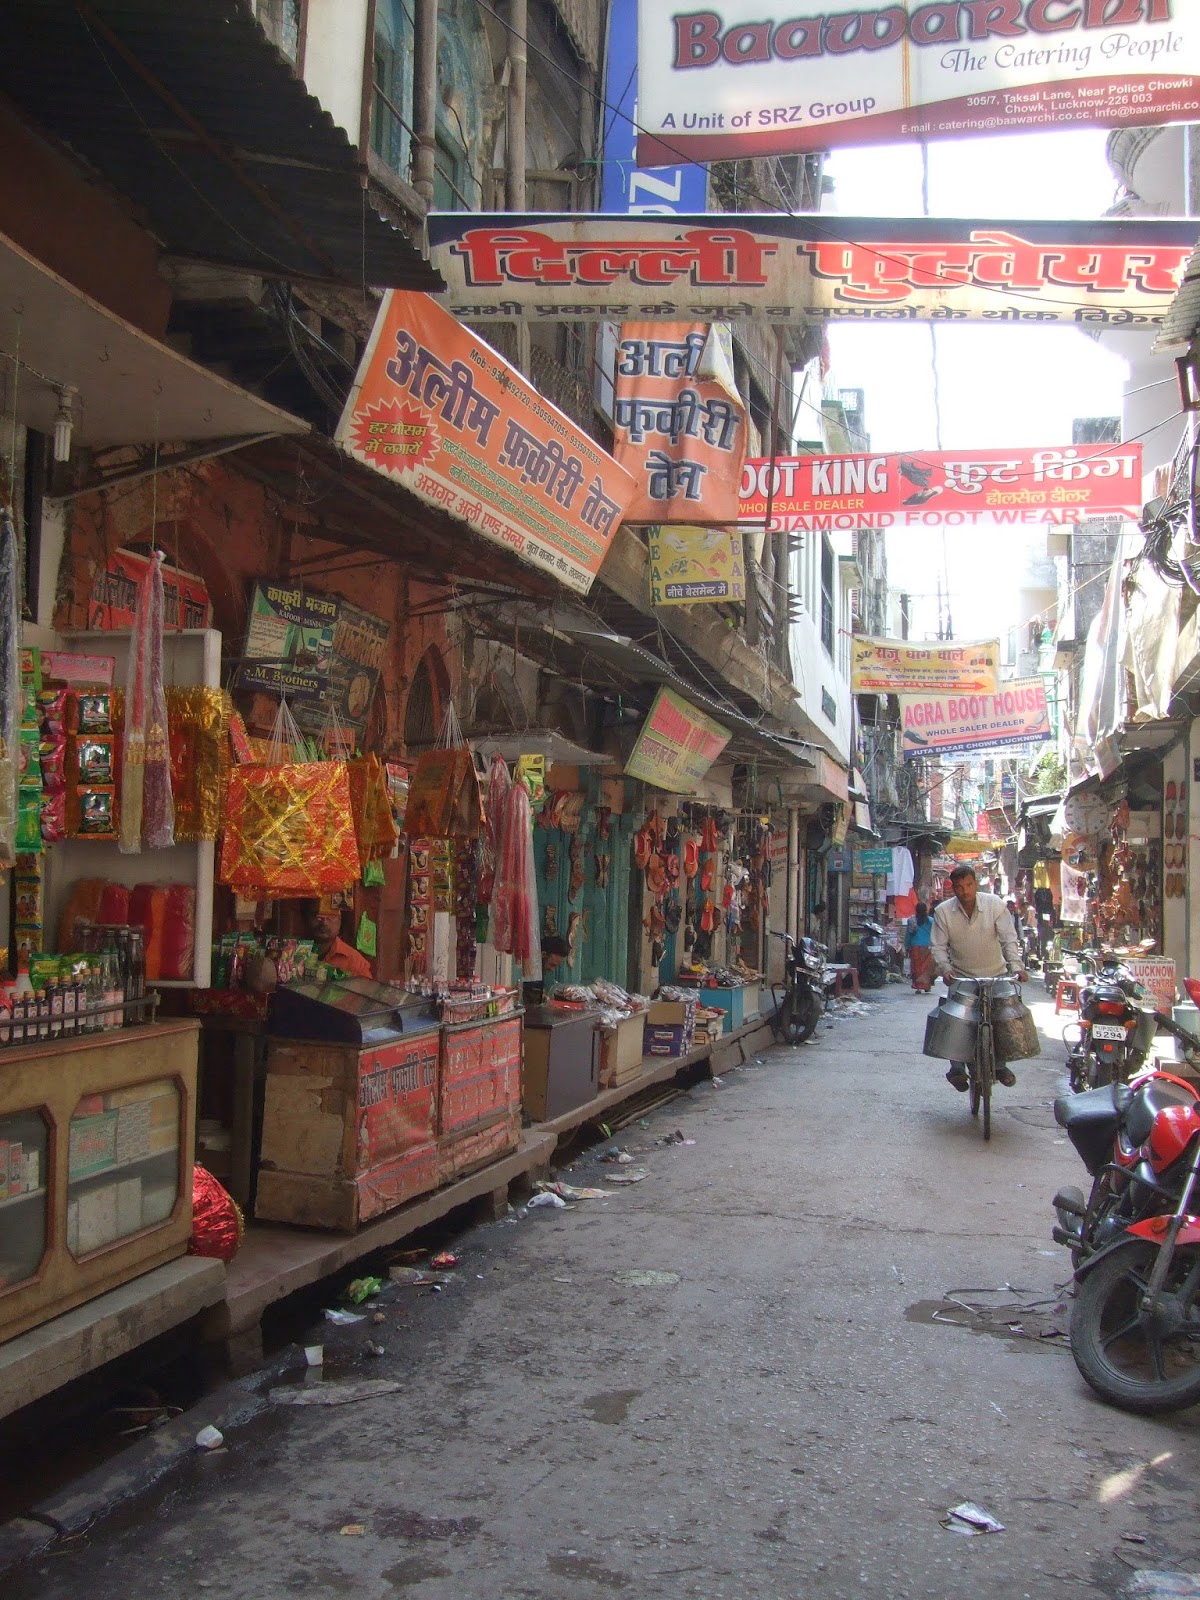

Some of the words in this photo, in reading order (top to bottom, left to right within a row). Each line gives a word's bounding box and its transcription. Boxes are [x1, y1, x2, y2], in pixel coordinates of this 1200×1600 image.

[940, 48, 987, 72] The
[994, 41, 1091, 71] Catering
[1100, 31, 1183, 61] People
[967, 97, 1000, 107] 305/7,
[1003, 91, 1039, 103] Taksal
[1043, 90, 1074, 101] Lane,
[1078, 86, 1106, 98] Near
[1108, 83, 1145, 94] Police
[1148, 78, 1193, 91] Chowki
[661, 113, 677, 129] A
[683, 112, 724, 129] Unit
[731, 111, 752, 127] of
[758, 105, 802, 126] SRZ
[808, 96, 876, 119] Group
[1005, 103, 1047, 115] Chowk,
[1051, 96, 1129, 111] Lucknow-226
[1131, 94, 1153, 104] 003
[901, 122, 931, 134] E-mail
[452, 228, 779, 286] दिल्ली
[797, 230, 1194, 303] फुटवेयर
[450, 300, 523, 316] सभी
[535, 301, 631, 317] प्रकार
[640, 300, 680, 316] के
[690, 300, 757, 320] जूते
[931, 306, 974, 321] के
[982, 306, 1061, 322] थोक
[470, 348, 486, 369] Mob
[619, 332, 706, 378] अली
[369, 421, 389, 434] हर
[386, 328, 501, 448] अलीम
[580, 475, 623, 539] तेल
[365, 438, 383, 454] में
[383, 440, 423, 456] लगायें
[1030, 448, 1138, 482] किंग
[739, 461, 799, 498] OOT
[812, 457, 888, 496] KING
[737, 501, 811, 514] WHOLESALE
[814, 499, 865, 511] DEALER
[985, 487, 1049, 506] होलसेल
[1050, 486, 1092, 503] डीलर
[456, 496, 482, 523] अली
[481, 511, 503, 536] एण्ड
[765, 512, 895, 532] DIAMOND
[905, 510, 984, 527] FOOT
[991, 508, 1081, 526] WEAR
[730, 540, 743, 598] EAR
[667, 584, 683, 598] नीचे
[685, 583, 716, 597] बेसमेन्ट
[717, 582, 727, 595] में
[273, 670, 319, 689] Brothers
[904, 701, 945, 728] AGRA
[950, 695, 989, 723] BOOT
[994, 687, 1047, 717] HOUSE
[926, 726, 957, 738] WHOLE
[959, 723, 988, 733] SALER
[990, 718, 1025, 730] DEALER
[912, 747, 934, 757] JUTA
[935, 743, 964, 754] BAZAR
[966, 739, 999, 750] CHOWK
[1134, 965, 1174, 977] LUCKNOW
[1148, 979, 1174, 988] CENTRE
[1096, 1031, 1122, 1040] 5294
[421, 1049, 437, 1088] तेल
